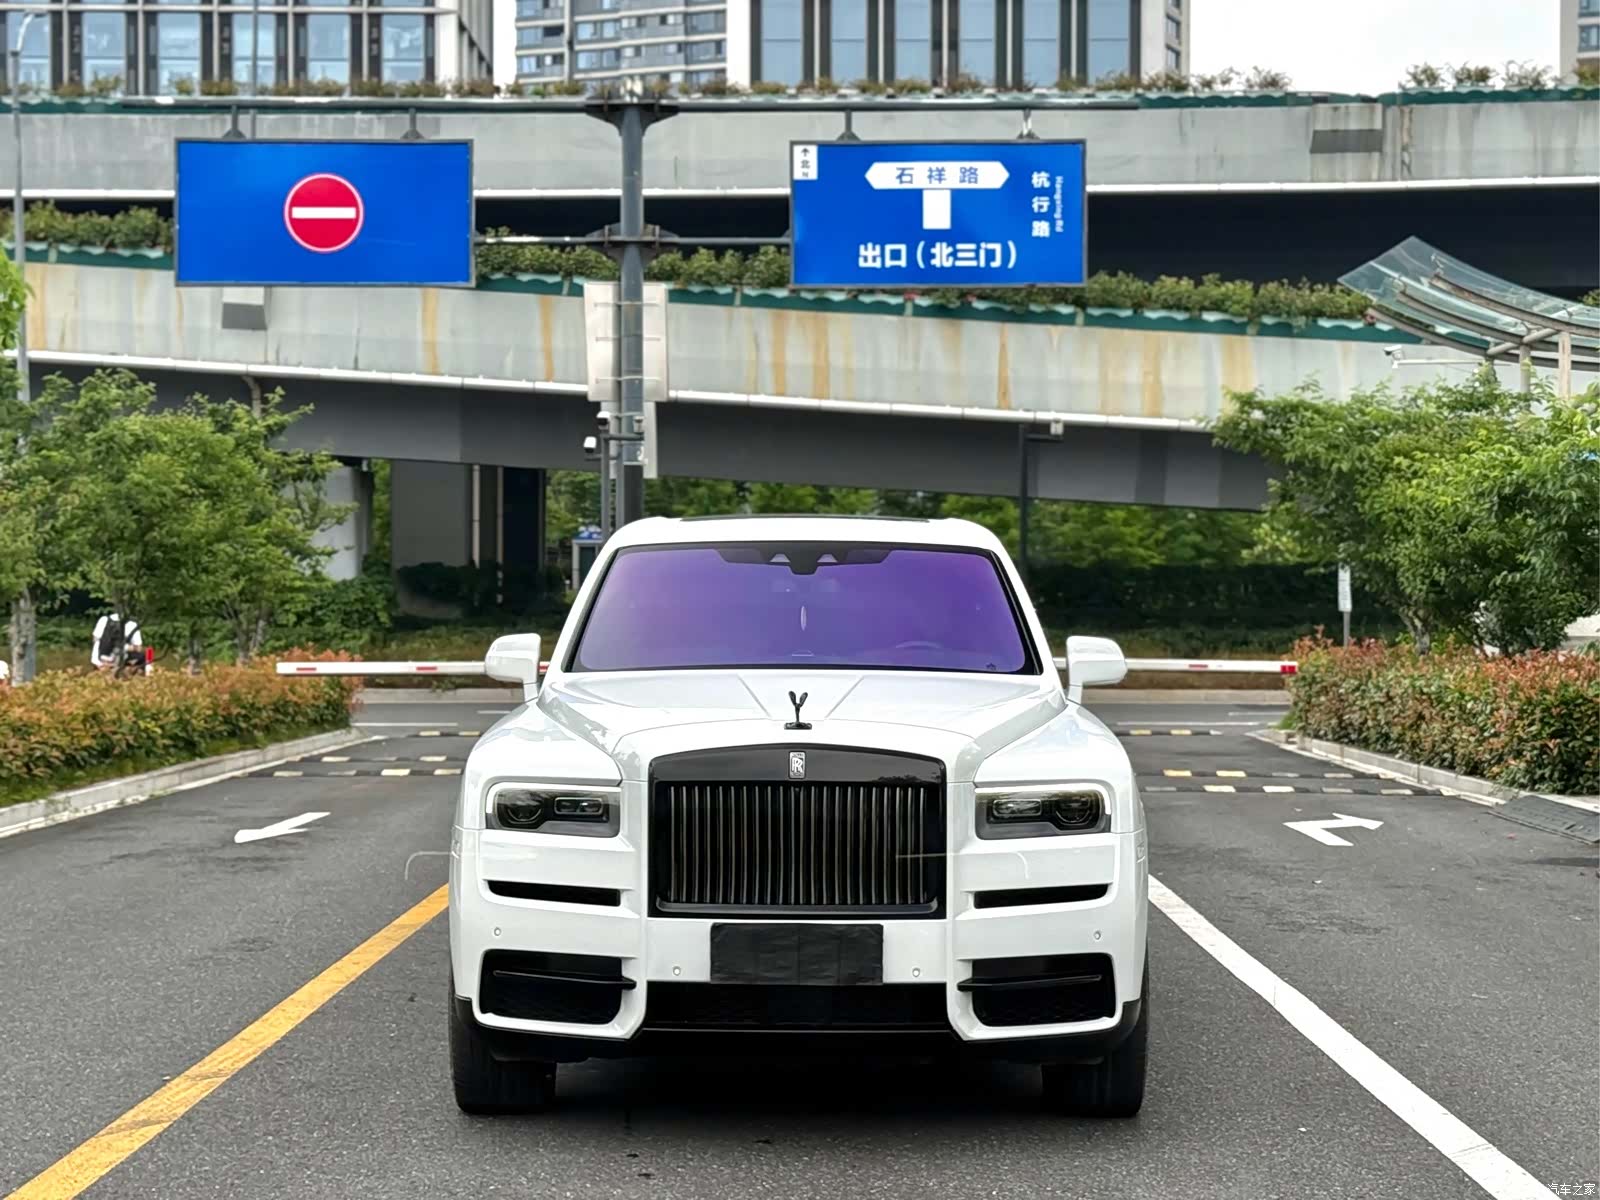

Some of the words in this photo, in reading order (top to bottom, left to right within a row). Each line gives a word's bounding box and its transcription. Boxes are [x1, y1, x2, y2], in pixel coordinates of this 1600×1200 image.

[800, 159, 811, 169] 北
[895, 166, 979, 184] 石祥路
[1031, 171, 1050, 237] 杭行路
[858, 241, 1017, 269] 出口（北三门）
